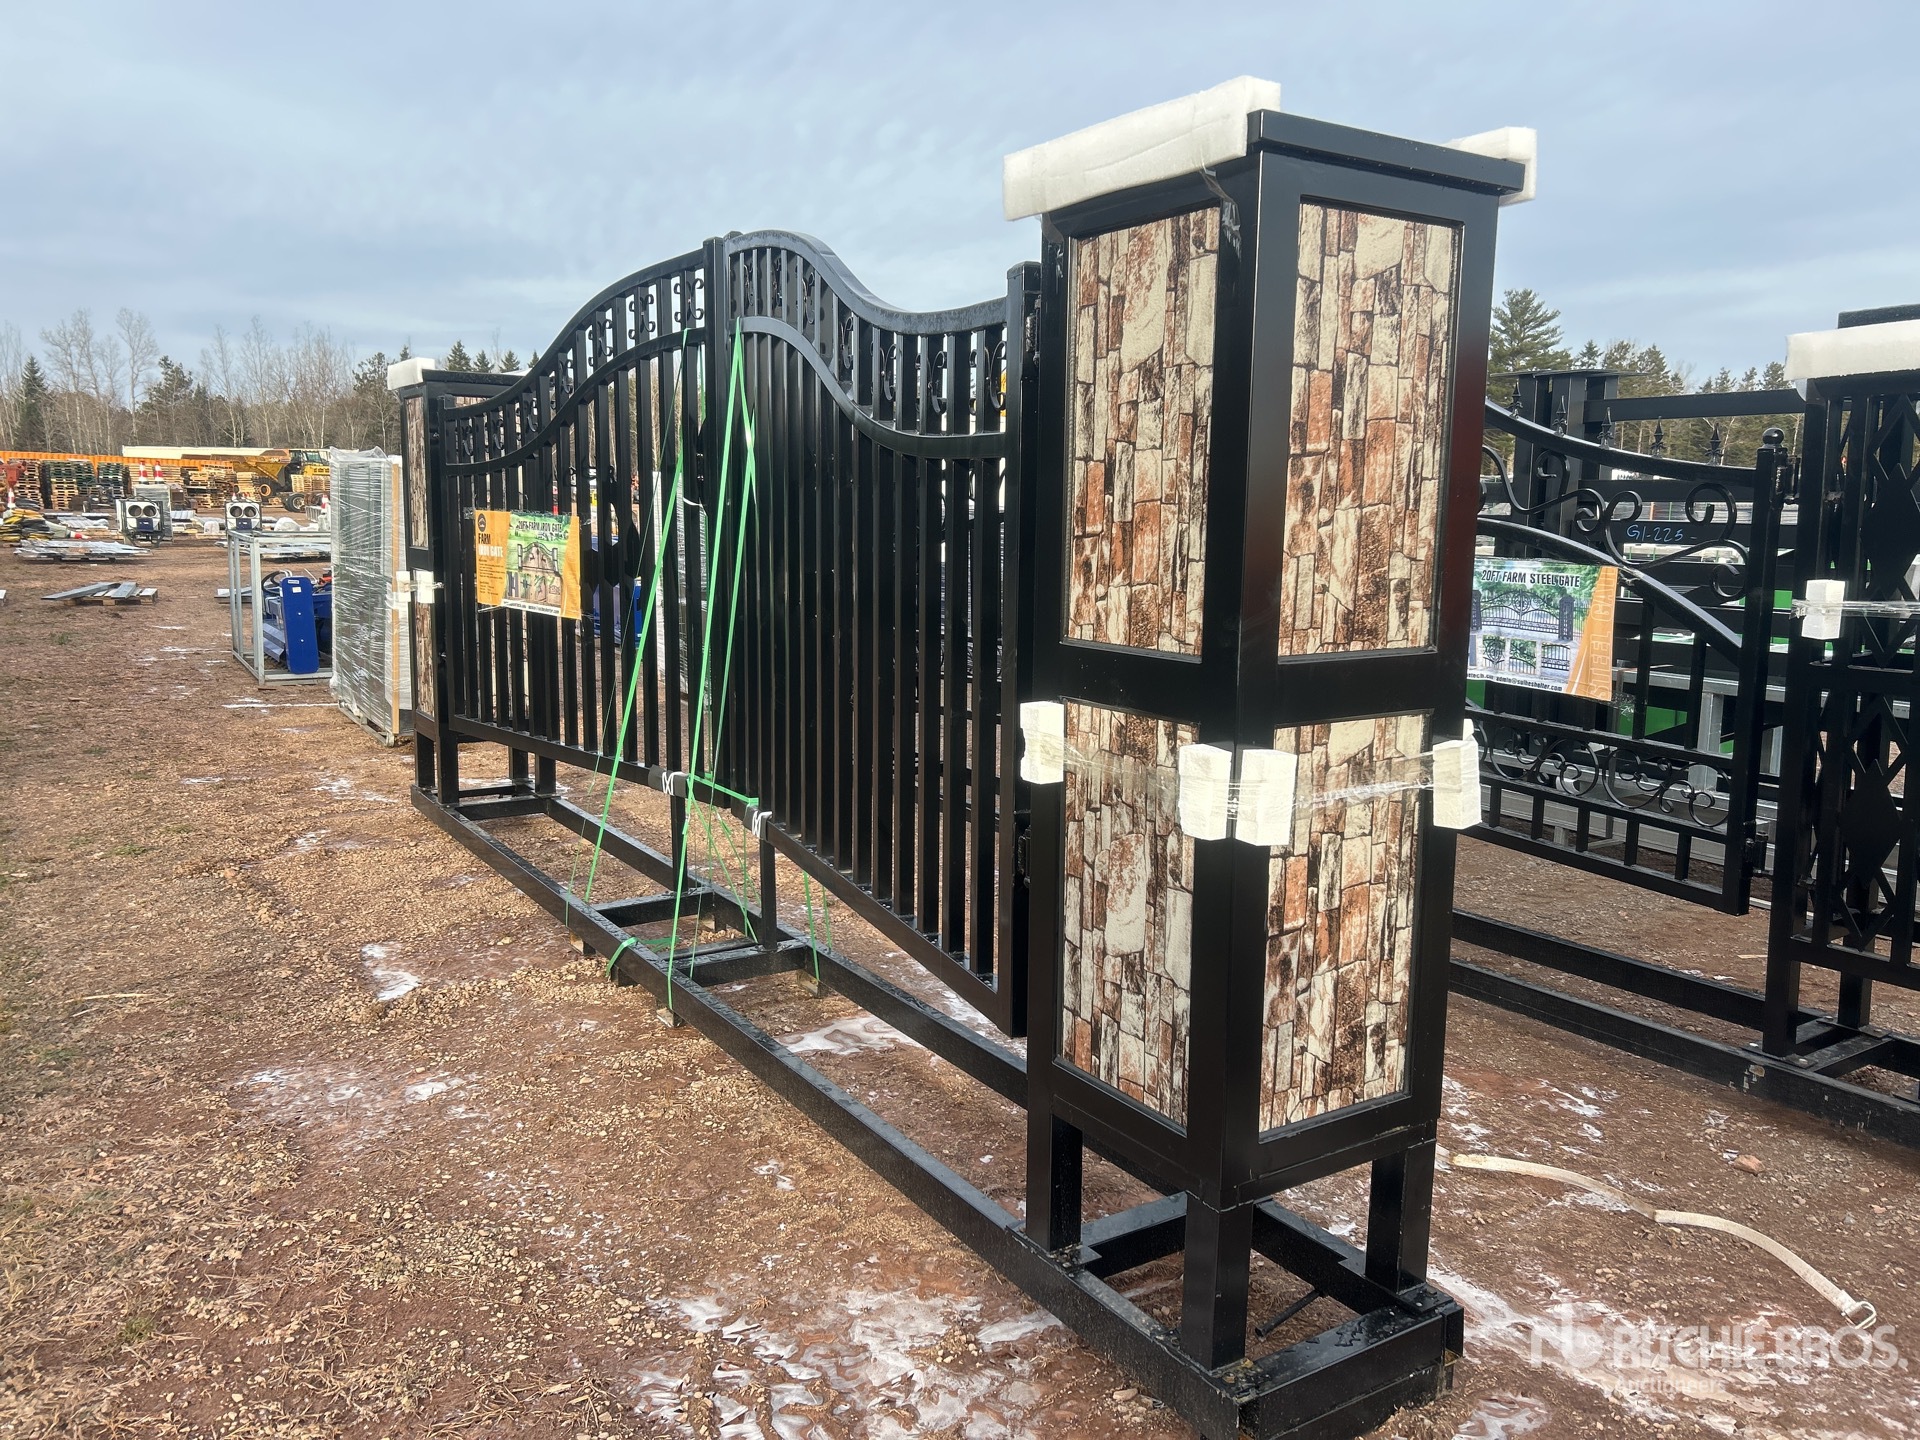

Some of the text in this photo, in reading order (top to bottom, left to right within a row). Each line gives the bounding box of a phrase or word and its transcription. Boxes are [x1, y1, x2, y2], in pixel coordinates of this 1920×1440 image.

[478, 533, 491, 545] FARM
[1481, 569, 1581, 588] 20FT FARM STEEL GATE
[1586, 631, 1611, 700] STEEL
